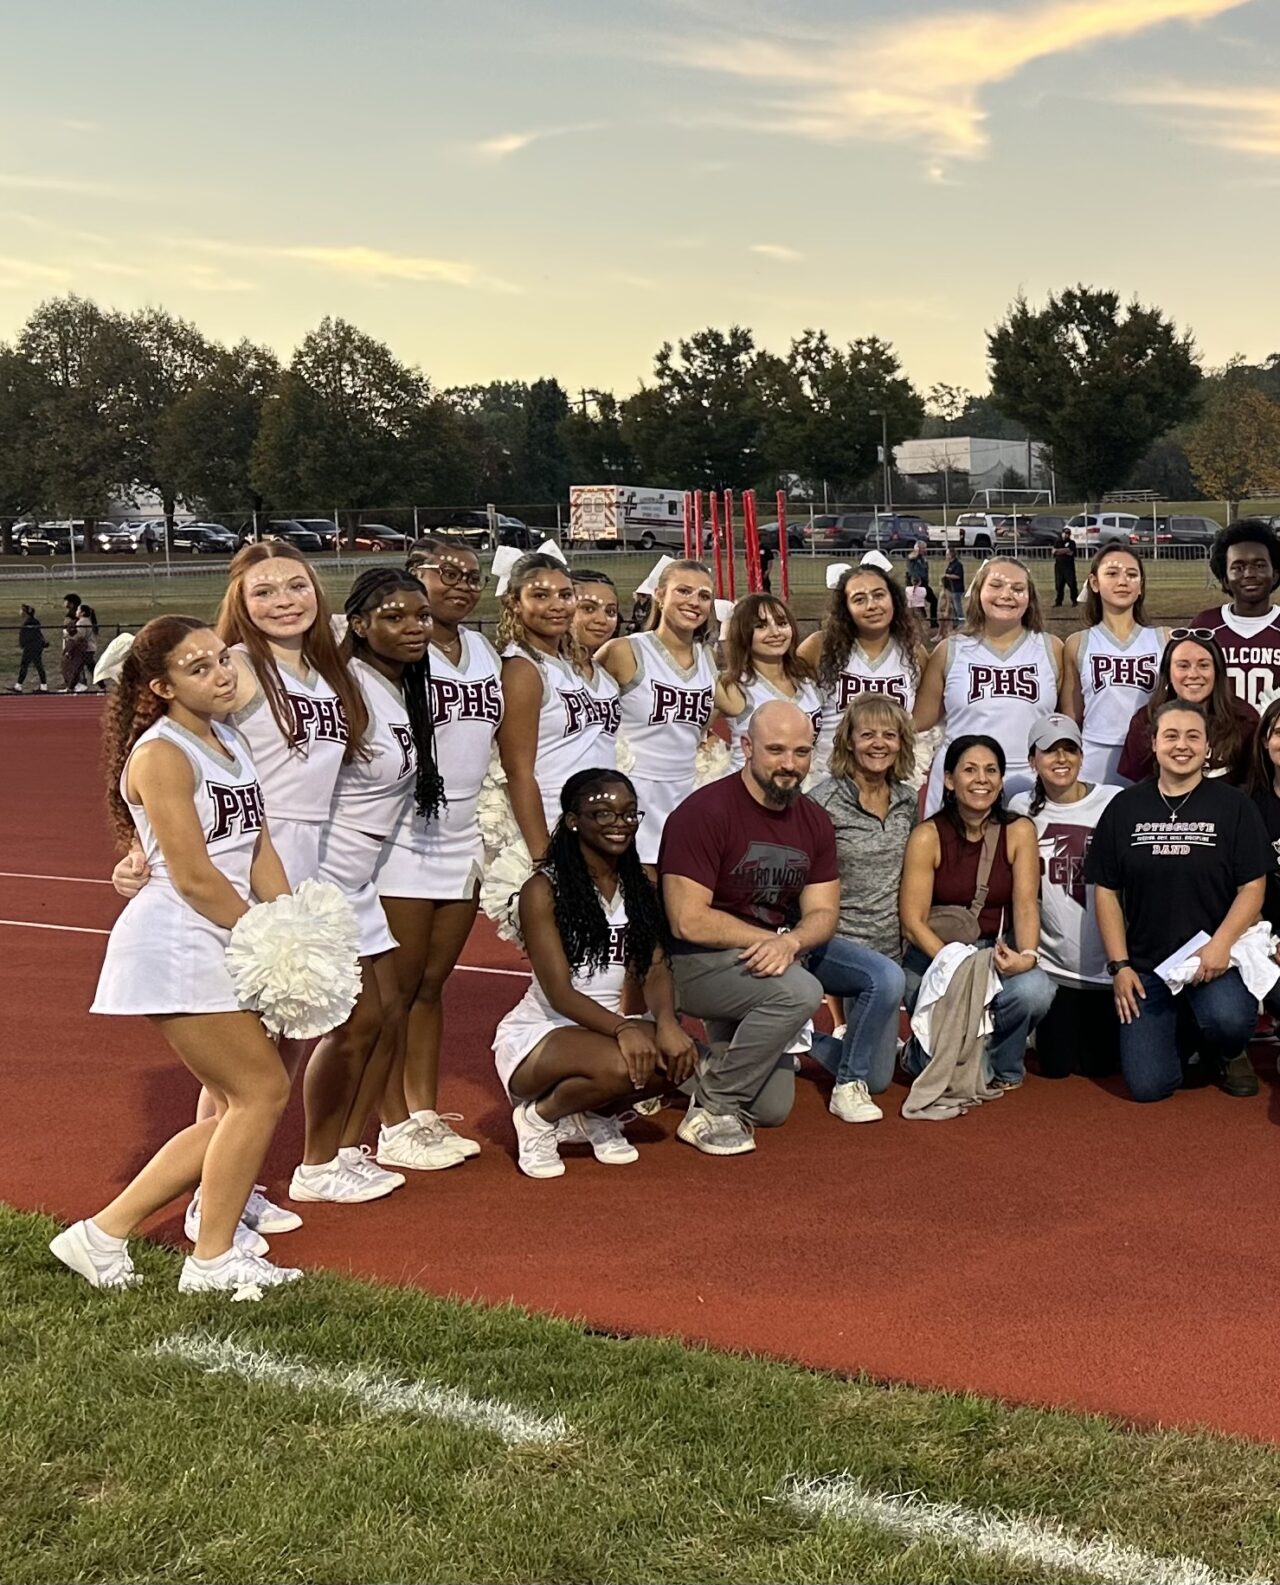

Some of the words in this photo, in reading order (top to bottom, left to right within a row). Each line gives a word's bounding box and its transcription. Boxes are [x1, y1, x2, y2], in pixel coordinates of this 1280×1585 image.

[967, 662, 1040, 704] PHS
[1089, 652, 1158, 695] PHS
[206, 779, 265, 844] PH
[1151, 844, 1191, 855] BAND
[770, 866, 807, 890] WOR
